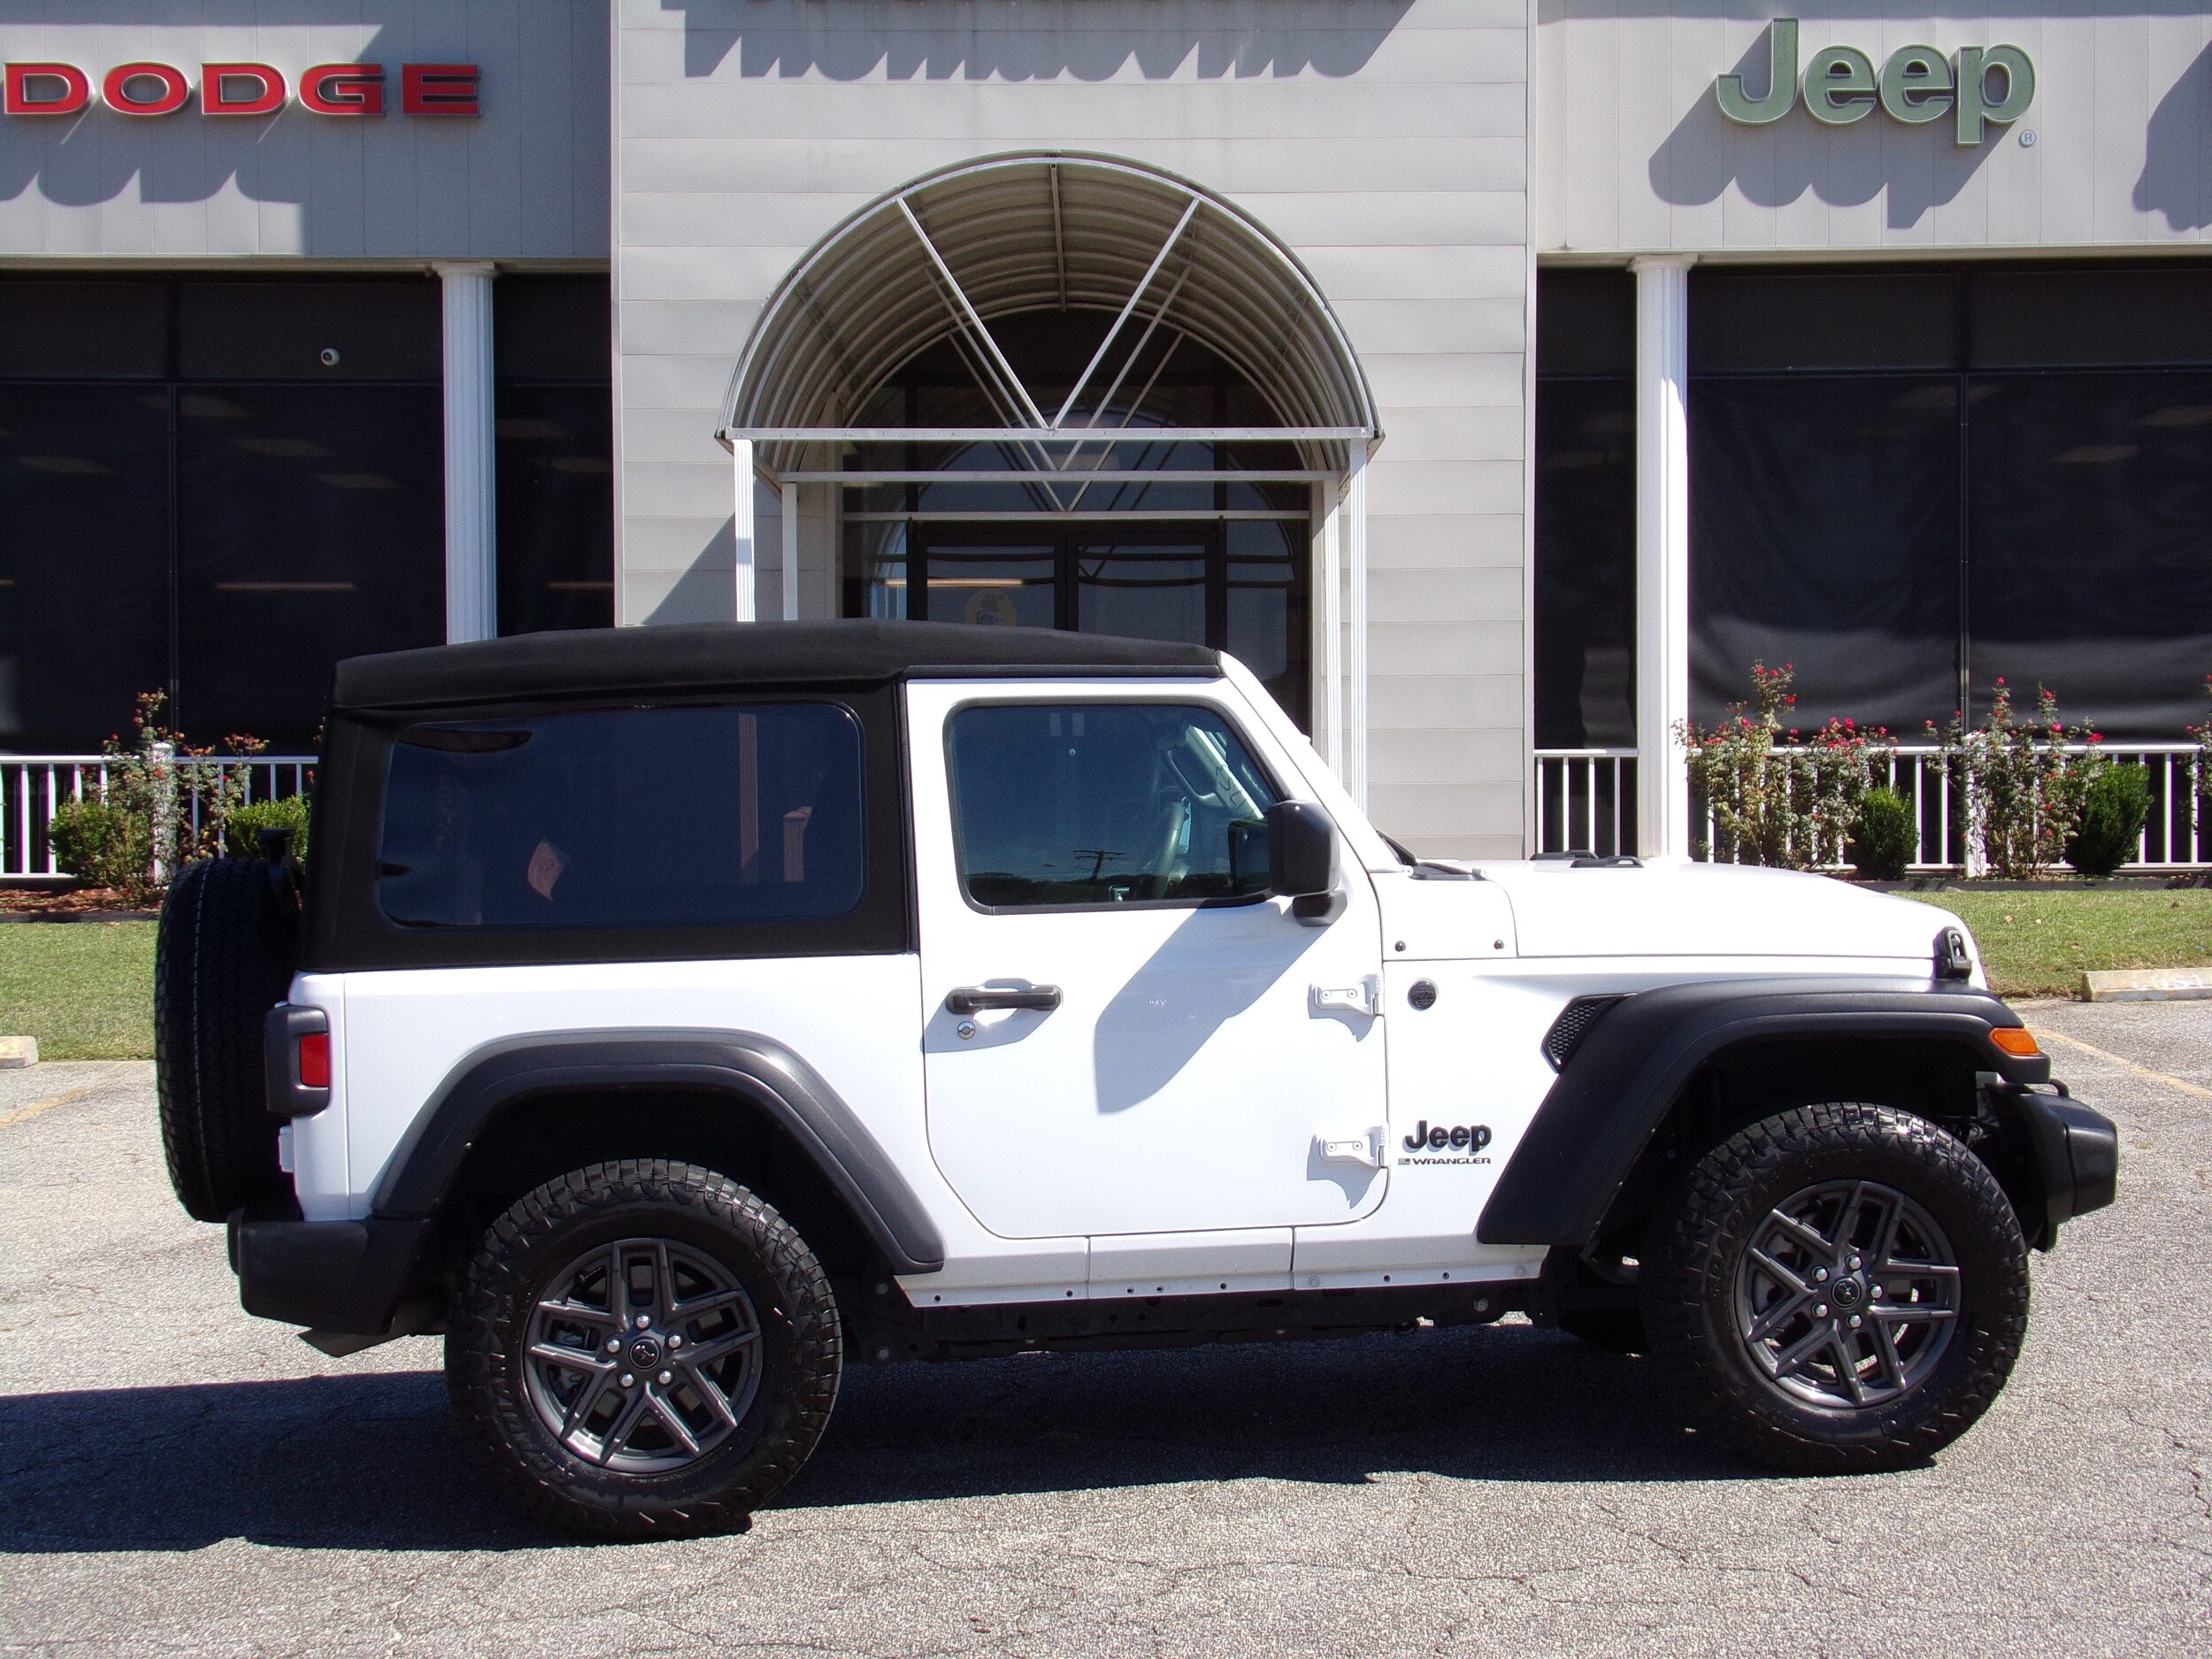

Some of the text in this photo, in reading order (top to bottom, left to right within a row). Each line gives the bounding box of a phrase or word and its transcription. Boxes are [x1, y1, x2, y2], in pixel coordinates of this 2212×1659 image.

[3, 61, 480, 117] DODGE
[1715, 17, 2036, 146] Jeep
[1404, 1119, 1493, 1153] Jeep
